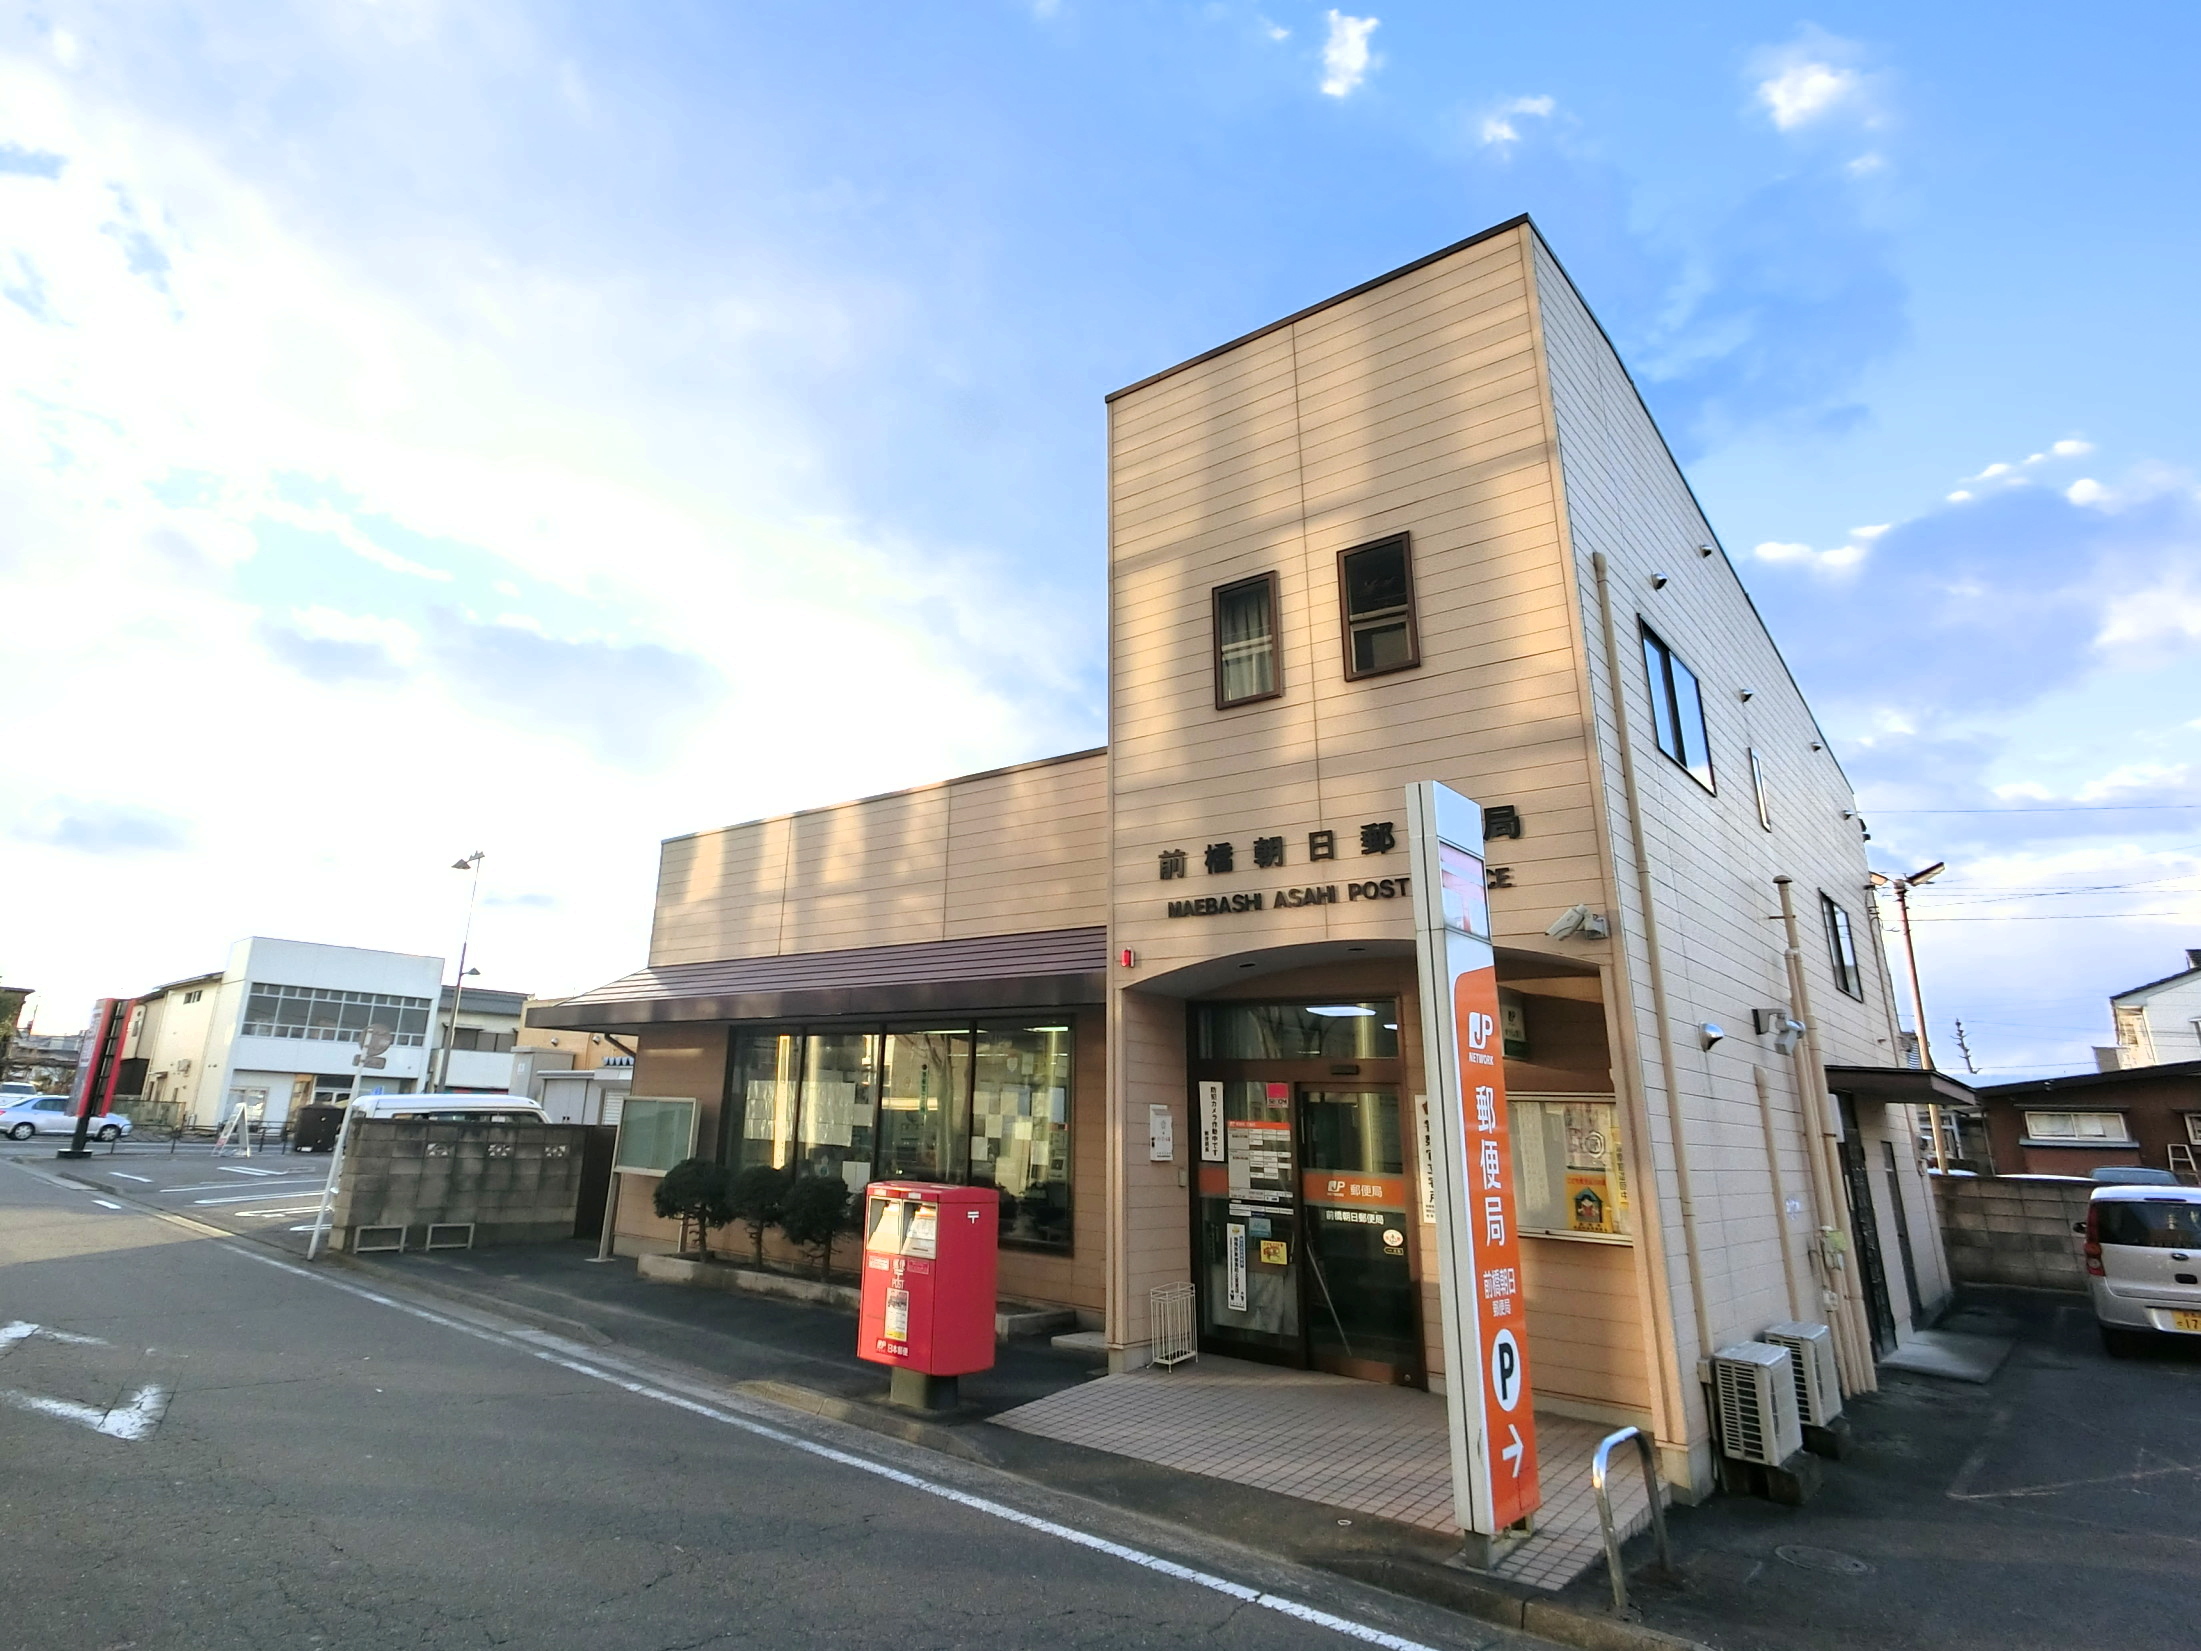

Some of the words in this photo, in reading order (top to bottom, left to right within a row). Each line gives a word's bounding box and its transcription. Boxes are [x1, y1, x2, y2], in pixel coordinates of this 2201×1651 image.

[1158, 804, 1521, 880] 前橋朝日郵局
[1168, 892, 1263, 918] MAEBASHI
[1273, 884, 1337, 909] ASAHI
[1348, 877, 1410, 901] POST
[1469, 1052, 1495, 1066] NETWORK
[1475, 1085, 1505, 1247] 郵便局
[1327, 1180, 1346, 1193] JP
[1350, 1184, 1383, 1198] 郵便局
[1326, 1210, 1384, 1226] 前橋朝日郵便局
[891, 1278, 905, 1290] POST
[1483, 1267, 1516, 1299] 前橋朝日
[1492, 1298, 1511, 1317] 郵便局
